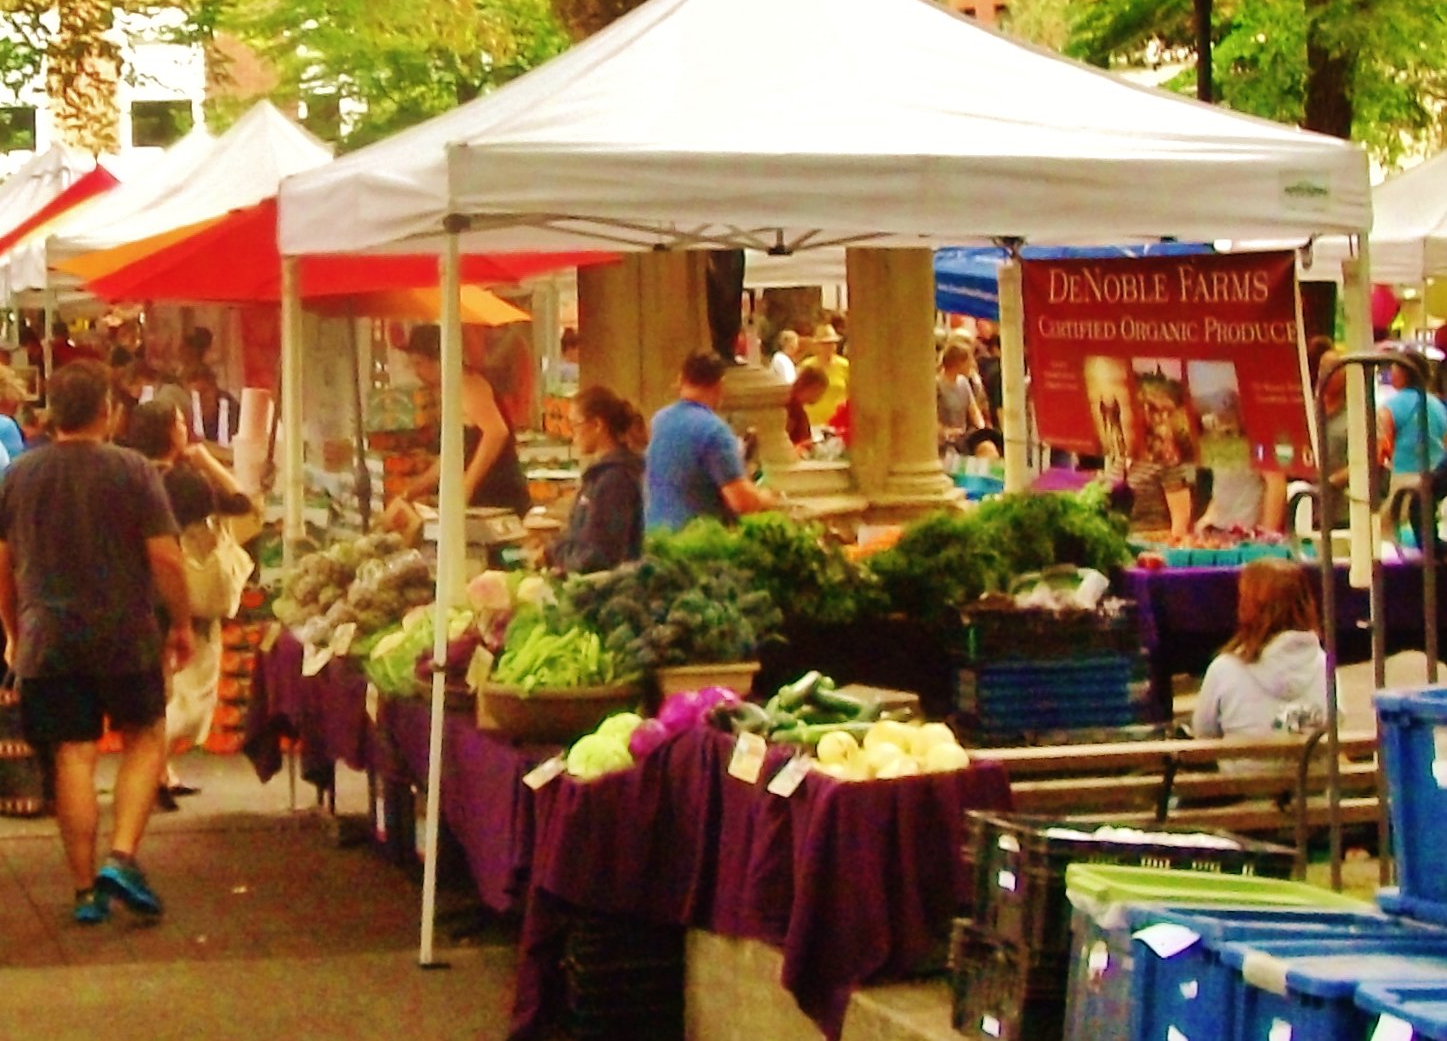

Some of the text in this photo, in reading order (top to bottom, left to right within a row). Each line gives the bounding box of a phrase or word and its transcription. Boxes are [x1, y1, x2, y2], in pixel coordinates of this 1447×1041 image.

[1178, 265, 1270, 304] FARMS
[1120, 315, 1198, 342] ORGANIC
[1204, 316, 1296, 344] PRODUCE
